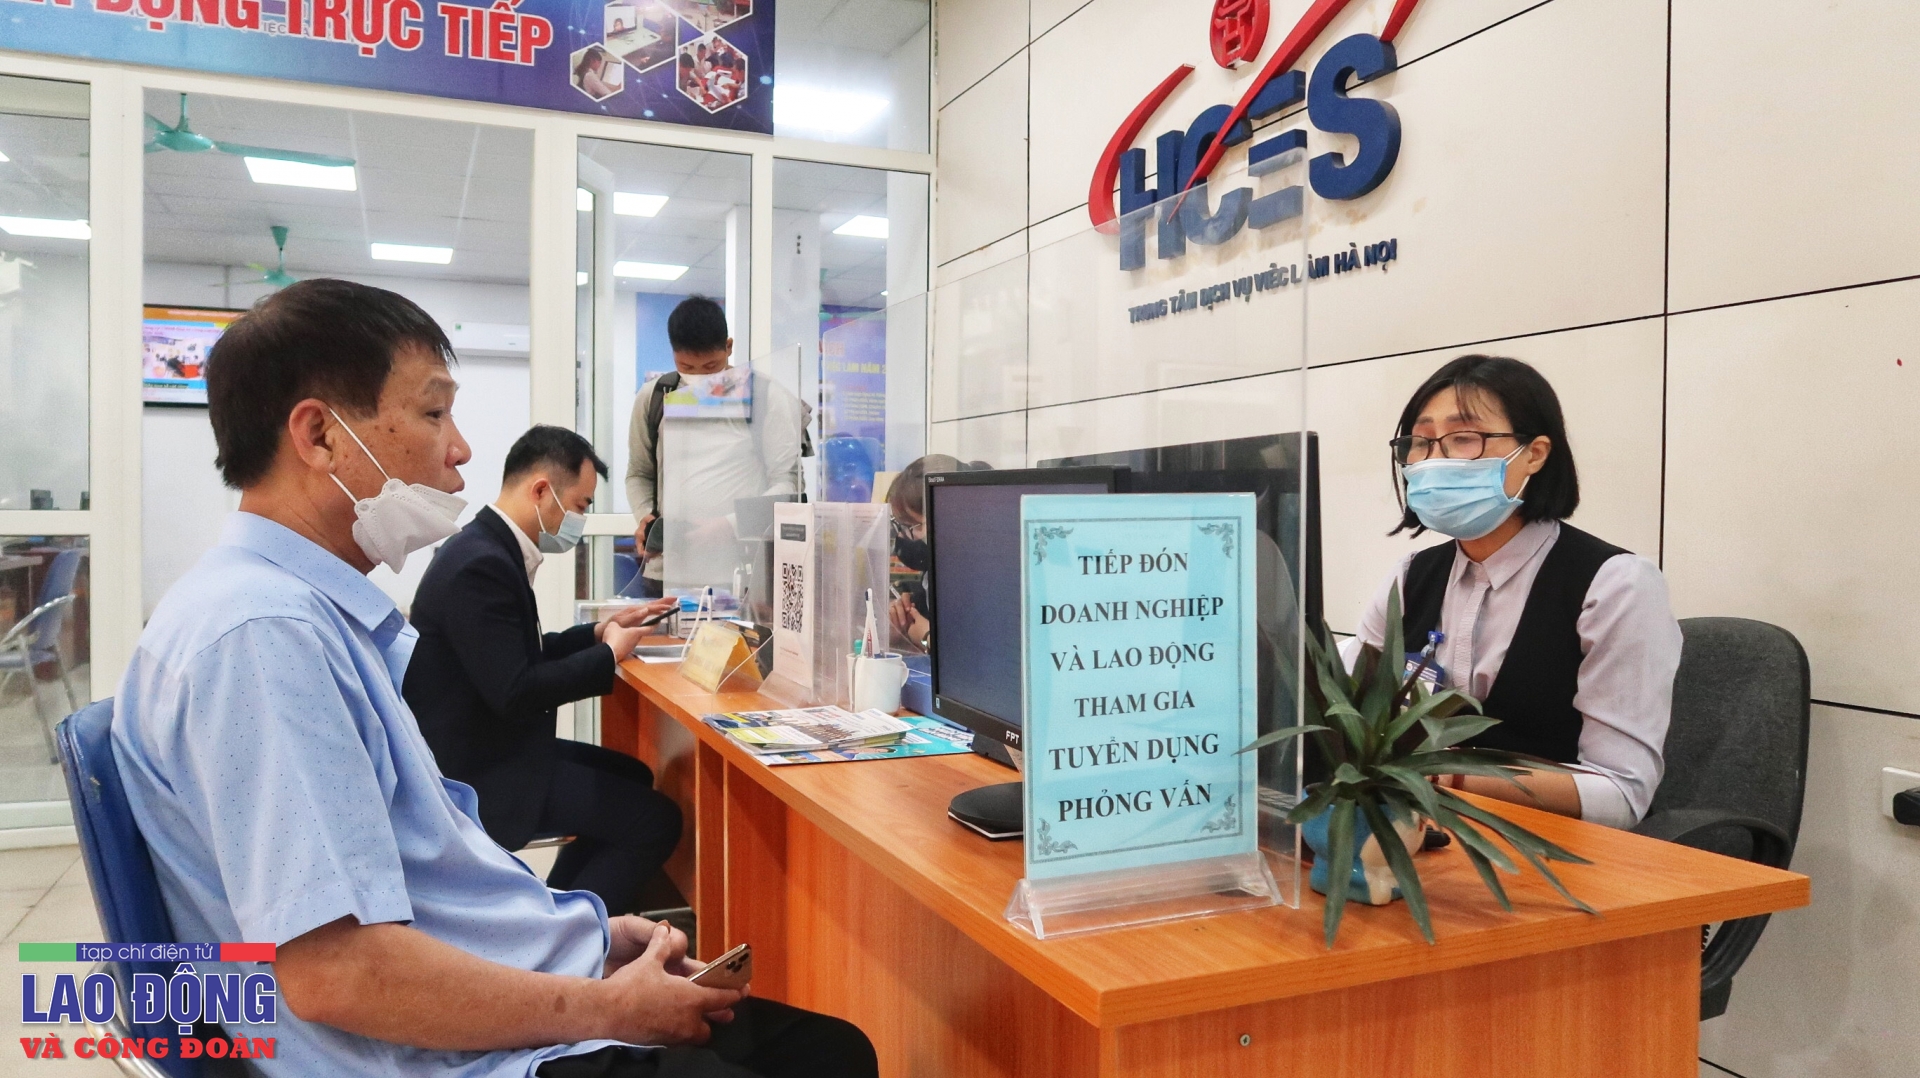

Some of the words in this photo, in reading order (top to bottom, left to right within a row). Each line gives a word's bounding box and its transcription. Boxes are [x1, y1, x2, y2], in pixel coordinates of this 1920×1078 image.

[286, 0, 424, 58] TRỰC
[438, 0, 553, 66] TIẾP
[1120, 33, 1402, 271] HCES
[1128, 299, 1168, 324] TRUNG
[1169, 289, 1198, 314] TÂM
[1199, 281, 1231, 311] DỊCH
[1232, 275, 1253, 303] VỤ
[1290, 253, 1330, 284] LÀM
[1334, 242, 1361, 274] HÀ
[1078, 548, 1133, 576] TIẾP
[1139, 547, 1189, 573] ĐÓN
[1040, 598, 1129, 625] DOANH
[1135, 593, 1224, 622] NGHIỆP
[1050, 644, 1085, 672] VÀ
[1092, 646, 1142, 670] LAO
[1149, 640, 1215, 669] ĐỘNG
[1074, 693, 1146, 718] THAM
[1152, 689, 1196, 712] GIA
[1005, 730, 1020, 745] FPT
[1048, 735, 1139, 771] TUYỂN
[1146, 732, 1220, 763] DỤNG
[1058, 788, 1152, 823] PHỎNG
[1159, 778, 1212, 809] VẤN
